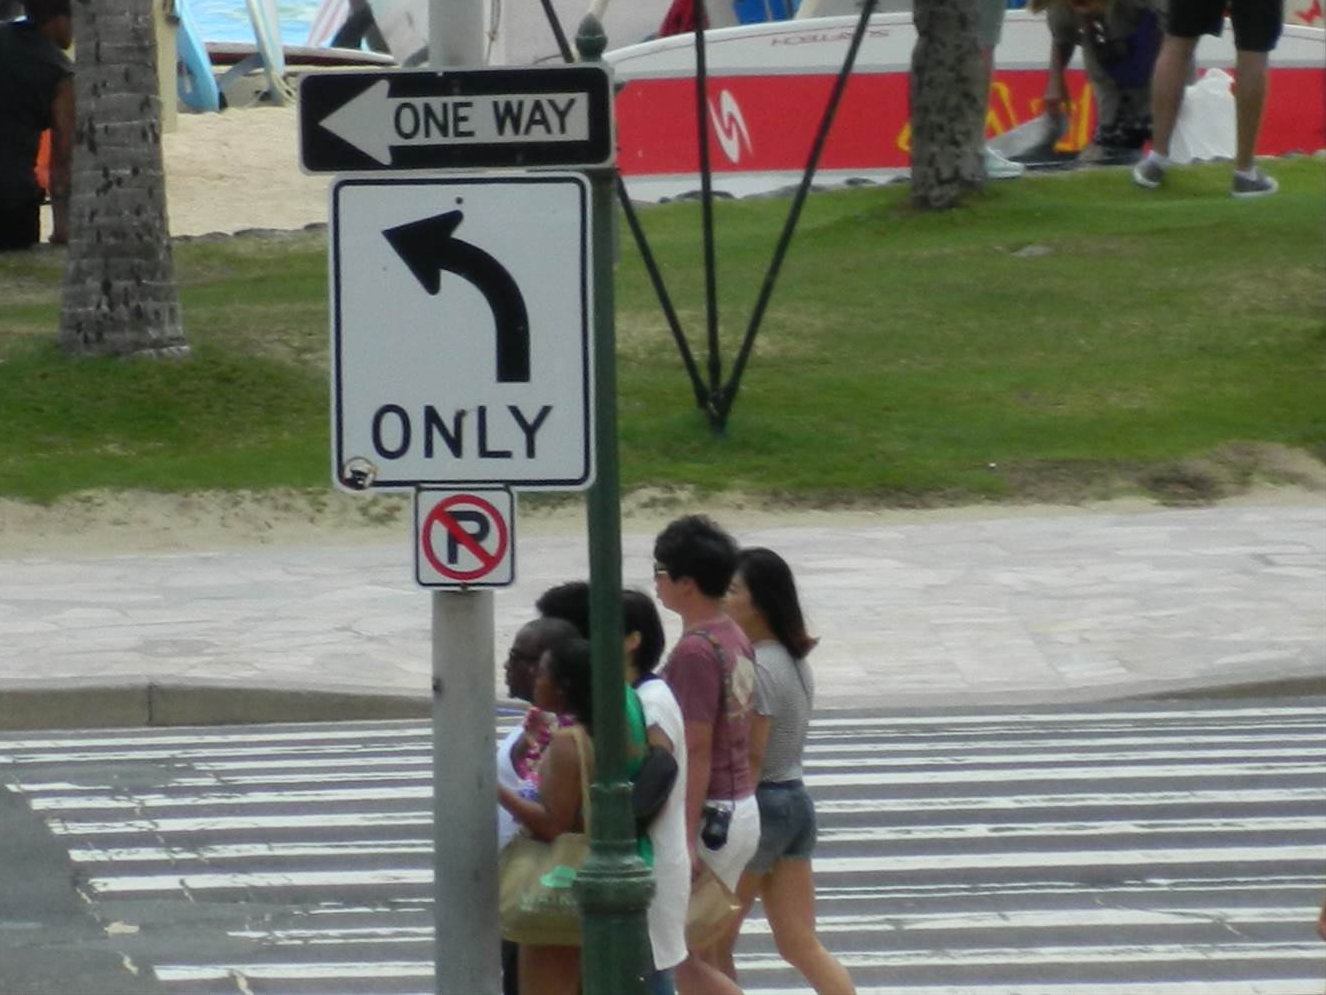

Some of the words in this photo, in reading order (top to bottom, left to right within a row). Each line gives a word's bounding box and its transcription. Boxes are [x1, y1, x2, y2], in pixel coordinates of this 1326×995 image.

[393, 100, 473, 139] ONE
[493, 98, 578, 136] WAY
[372, 404, 553, 460] ONLY
